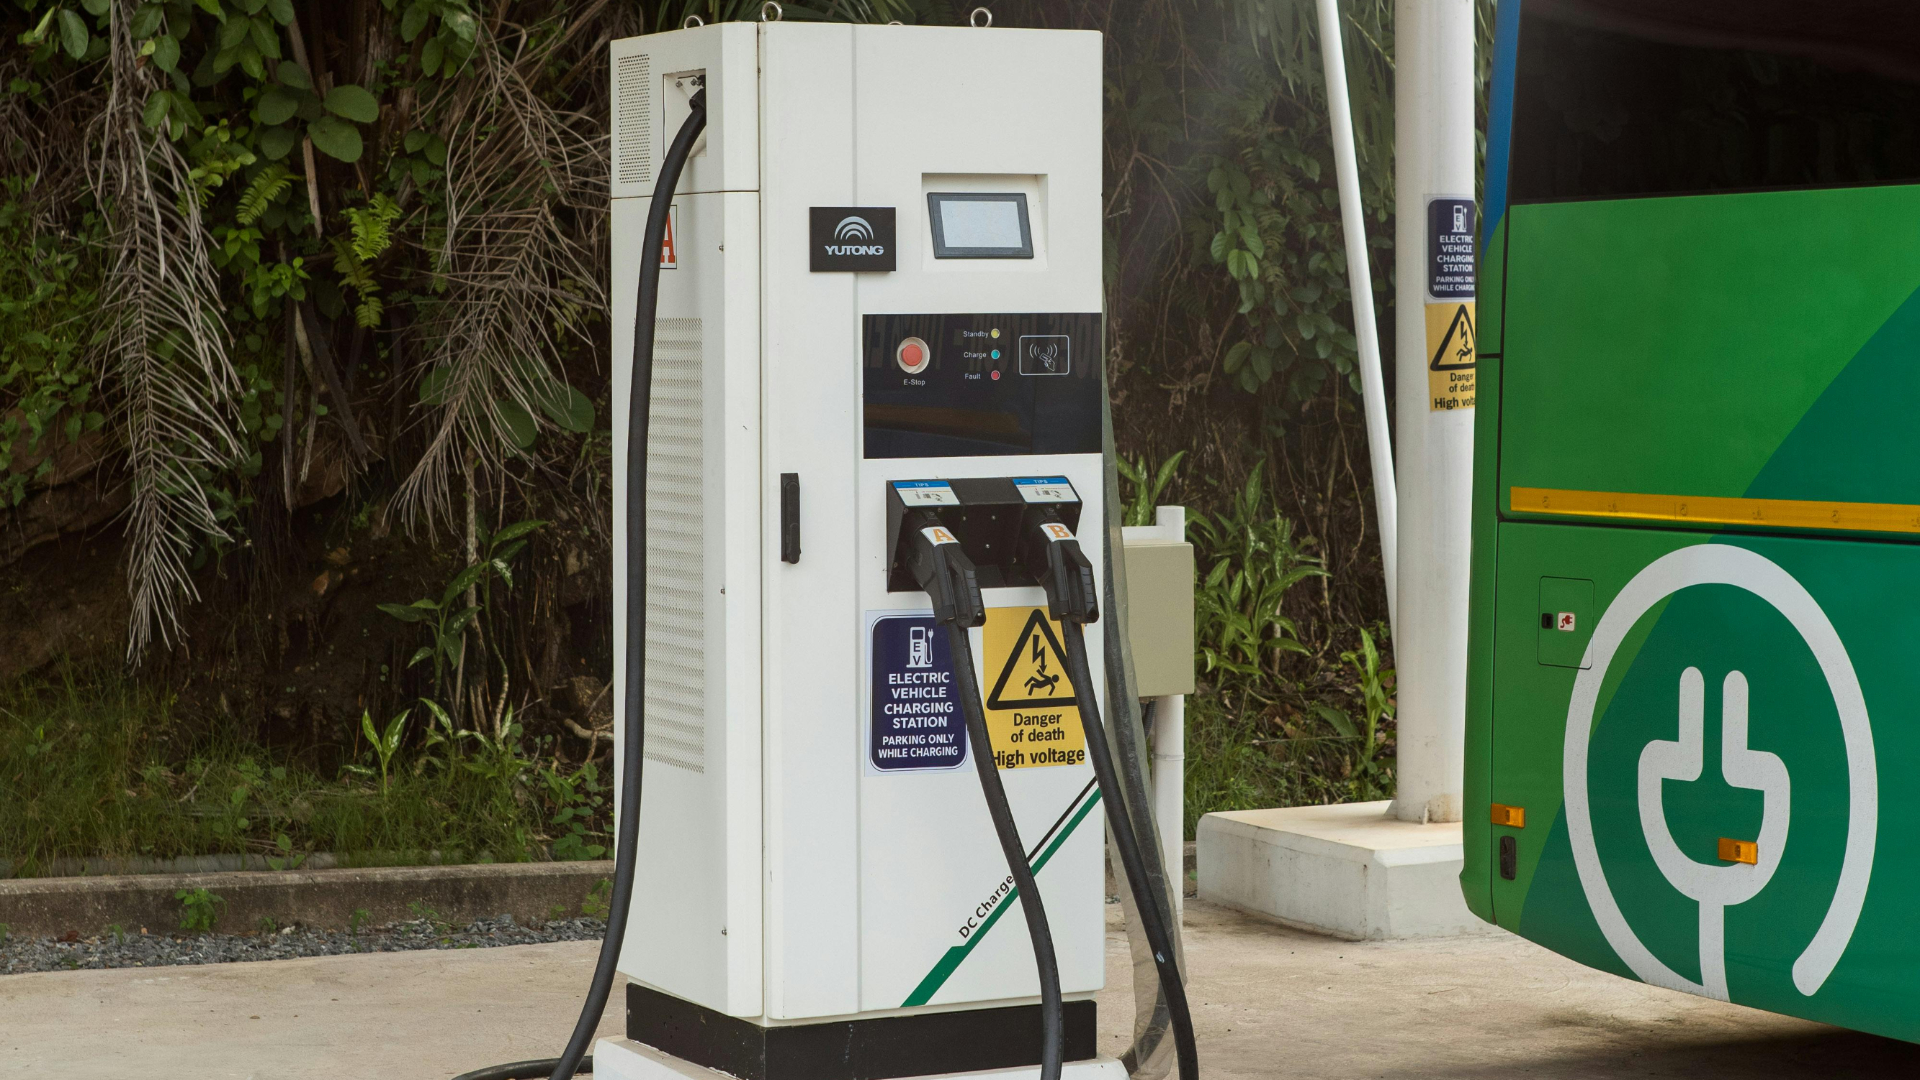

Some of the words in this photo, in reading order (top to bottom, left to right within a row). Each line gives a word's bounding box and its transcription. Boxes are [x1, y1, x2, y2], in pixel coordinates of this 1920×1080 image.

[1439, 235, 1474, 244] ELECTRIC
[824, 245, 885, 256] YUTONG
[1442, 244, 1473, 253] VEHICLE
[1443, 264, 1473, 273] STATION
[1435, 275, 1465, 284] PARKING
[1433, 284, 1455, 292] WHILE
[963, 330, 989, 339] Standby
[963, 351, 987, 360] Charge
[903, 378, 926, 387] E-Stop
[964, 372, 981, 380] Fault
[1448, 383, 1458, 393] of
[1434, 396, 1459, 410] High
[932, 528, 956, 543] A
[1046, 524, 1072, 539] B
[888, 671, 951, 685] ELECTRIC
[891, 686, 948, 700] VEHICLE
[884, 701, 954, 715] CHARGING
[892, 715, 948, 729] STATION
[1013, 712, 1063, 728] Danger
[882, 734, 926, 746] PARKING
[928, 733, 955, 744] ONLY
[1010, 729, 1024, 743] of
[1028, 727, 1065, 742] death
[878, 747, 908, 759] WHILE
[910, 745, 959, 757] CHARGING
[1029, 747, 1085, 765] voltage
[958, 916, 978, 939] DC
[975, 875, 1014, 919] Charge
